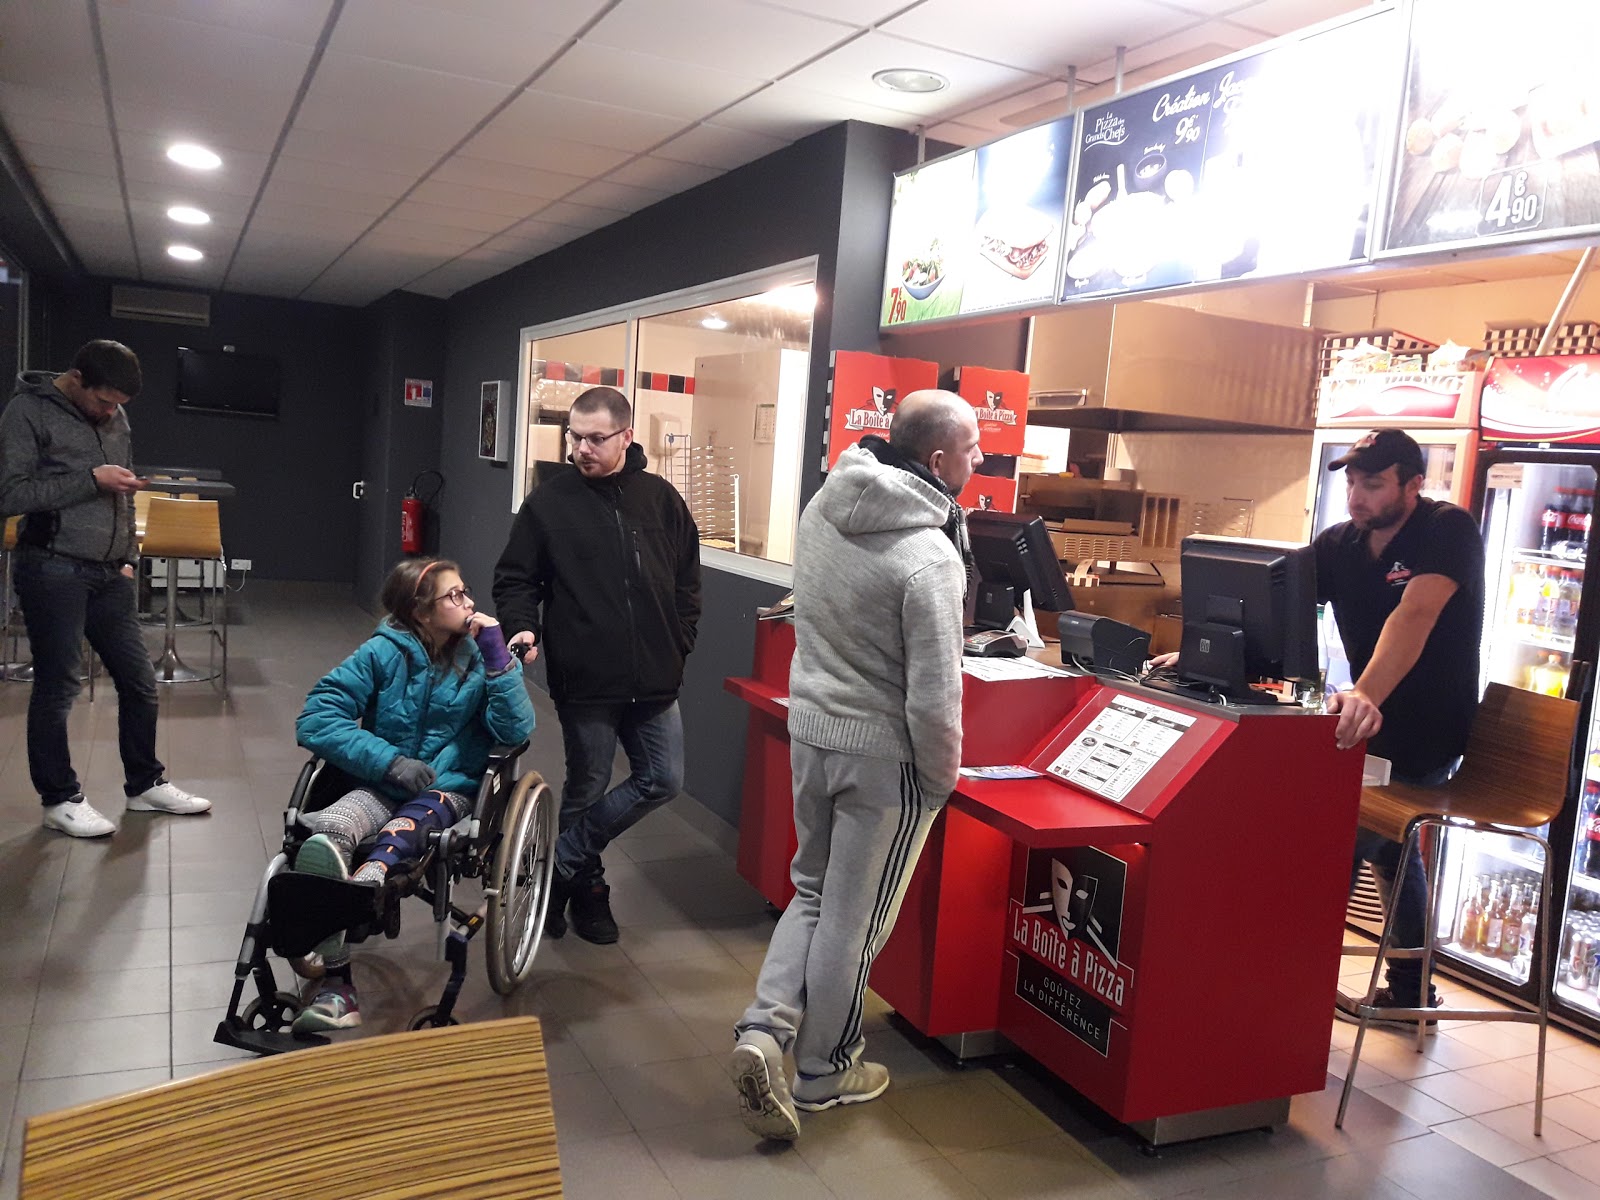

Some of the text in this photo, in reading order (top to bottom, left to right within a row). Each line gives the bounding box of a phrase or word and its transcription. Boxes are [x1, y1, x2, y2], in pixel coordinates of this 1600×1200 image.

[1095, 117, 1118, 133] Pizza
[1104, 124, 1126, 141] Chefs
[851, 410, 862, 425] La
[864, 412, 883, 427] Boîte
[1013, 907, 1125, 1006] La Boîte à Pizza
[1043, 976, 1081, 1010] GOÛTEZ
[1024, 980, 1100, 1040] LA DIFFÉRENCE
